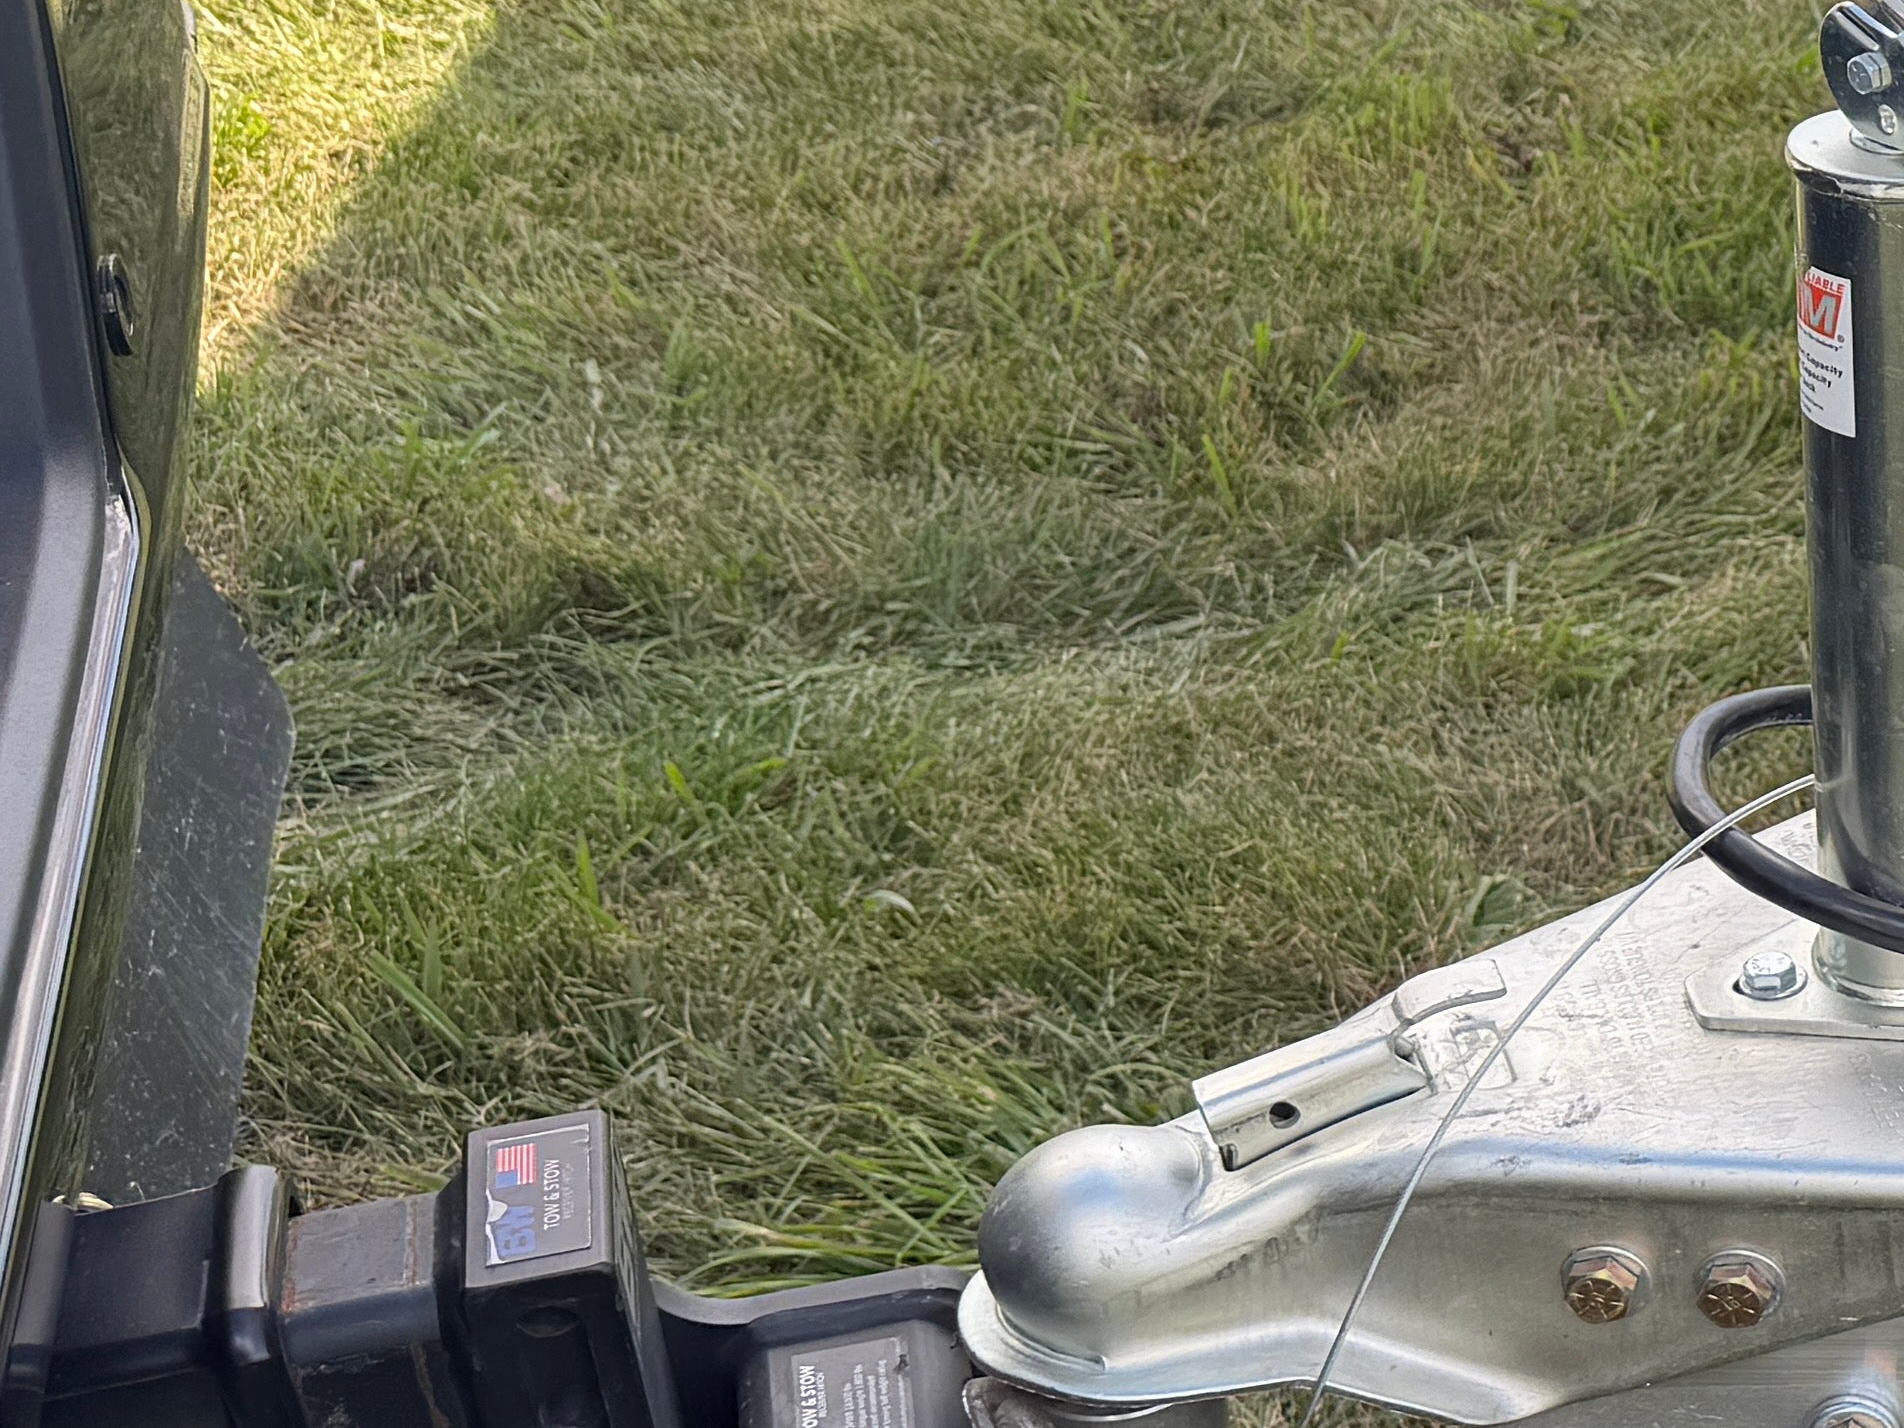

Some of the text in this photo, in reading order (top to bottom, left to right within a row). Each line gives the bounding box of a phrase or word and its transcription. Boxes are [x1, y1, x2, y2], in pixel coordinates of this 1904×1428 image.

[543, 1159, 561, 1230] TOW & STOW
[799, 1365, 817, 1397] STOW
[801, 1397, 817, 1407] &
